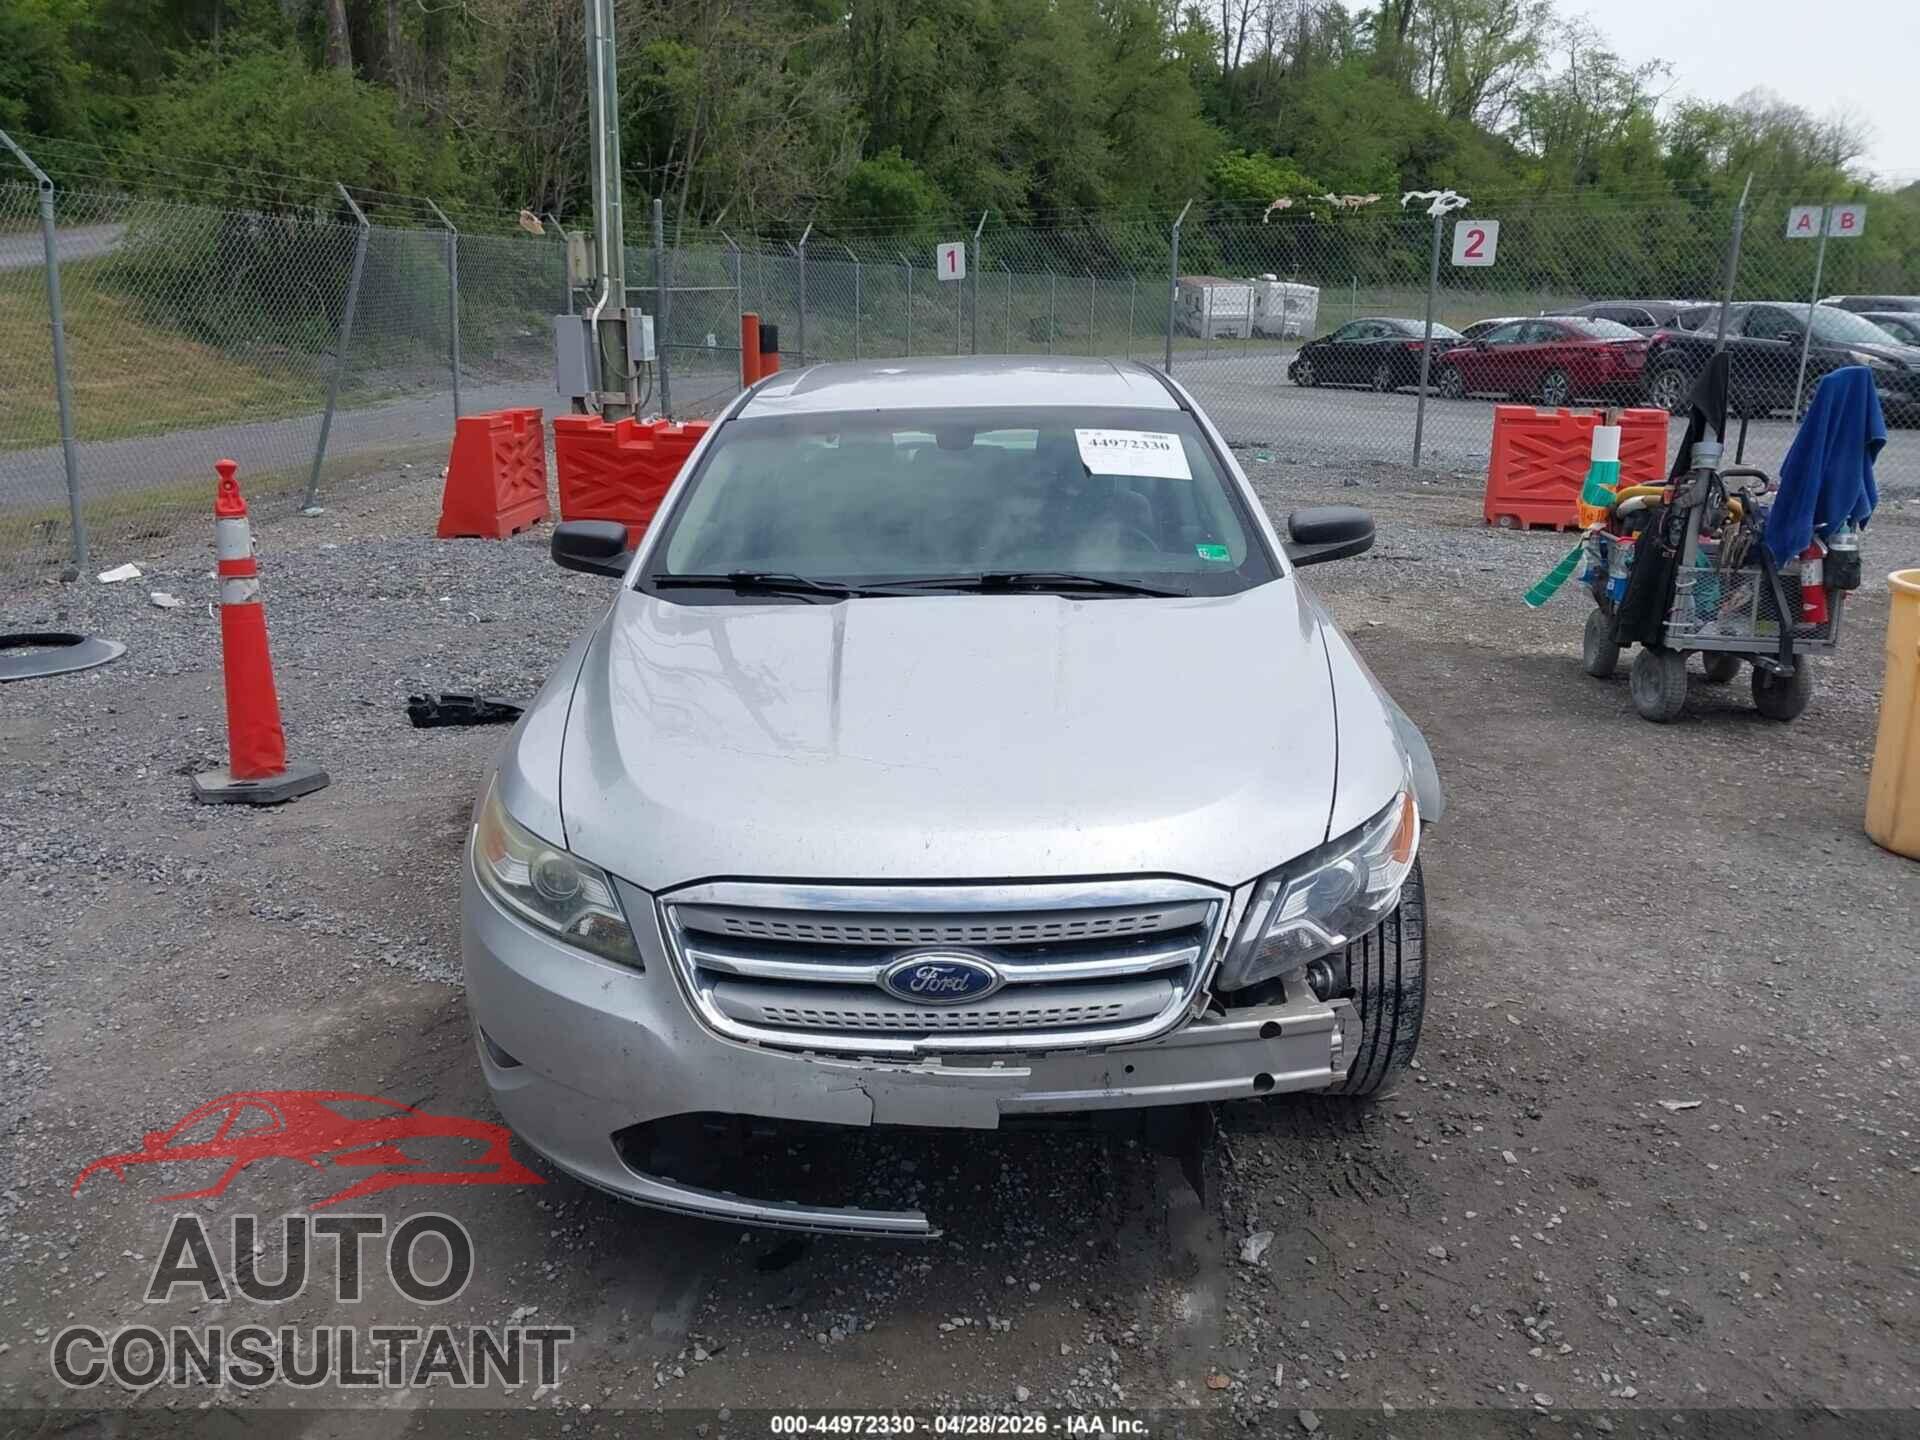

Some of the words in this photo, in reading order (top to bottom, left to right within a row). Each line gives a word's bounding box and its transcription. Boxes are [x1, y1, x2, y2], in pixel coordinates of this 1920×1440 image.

[1796, 214, 1811, 230] A
[1840, 212, 1855, 229] B
[1464, 229, 1486, 258] 2
[946, 250, 956, 273] 1
[1088, 438, 1170, 451] 44972330
[910, 966, 970, 991] Ford
